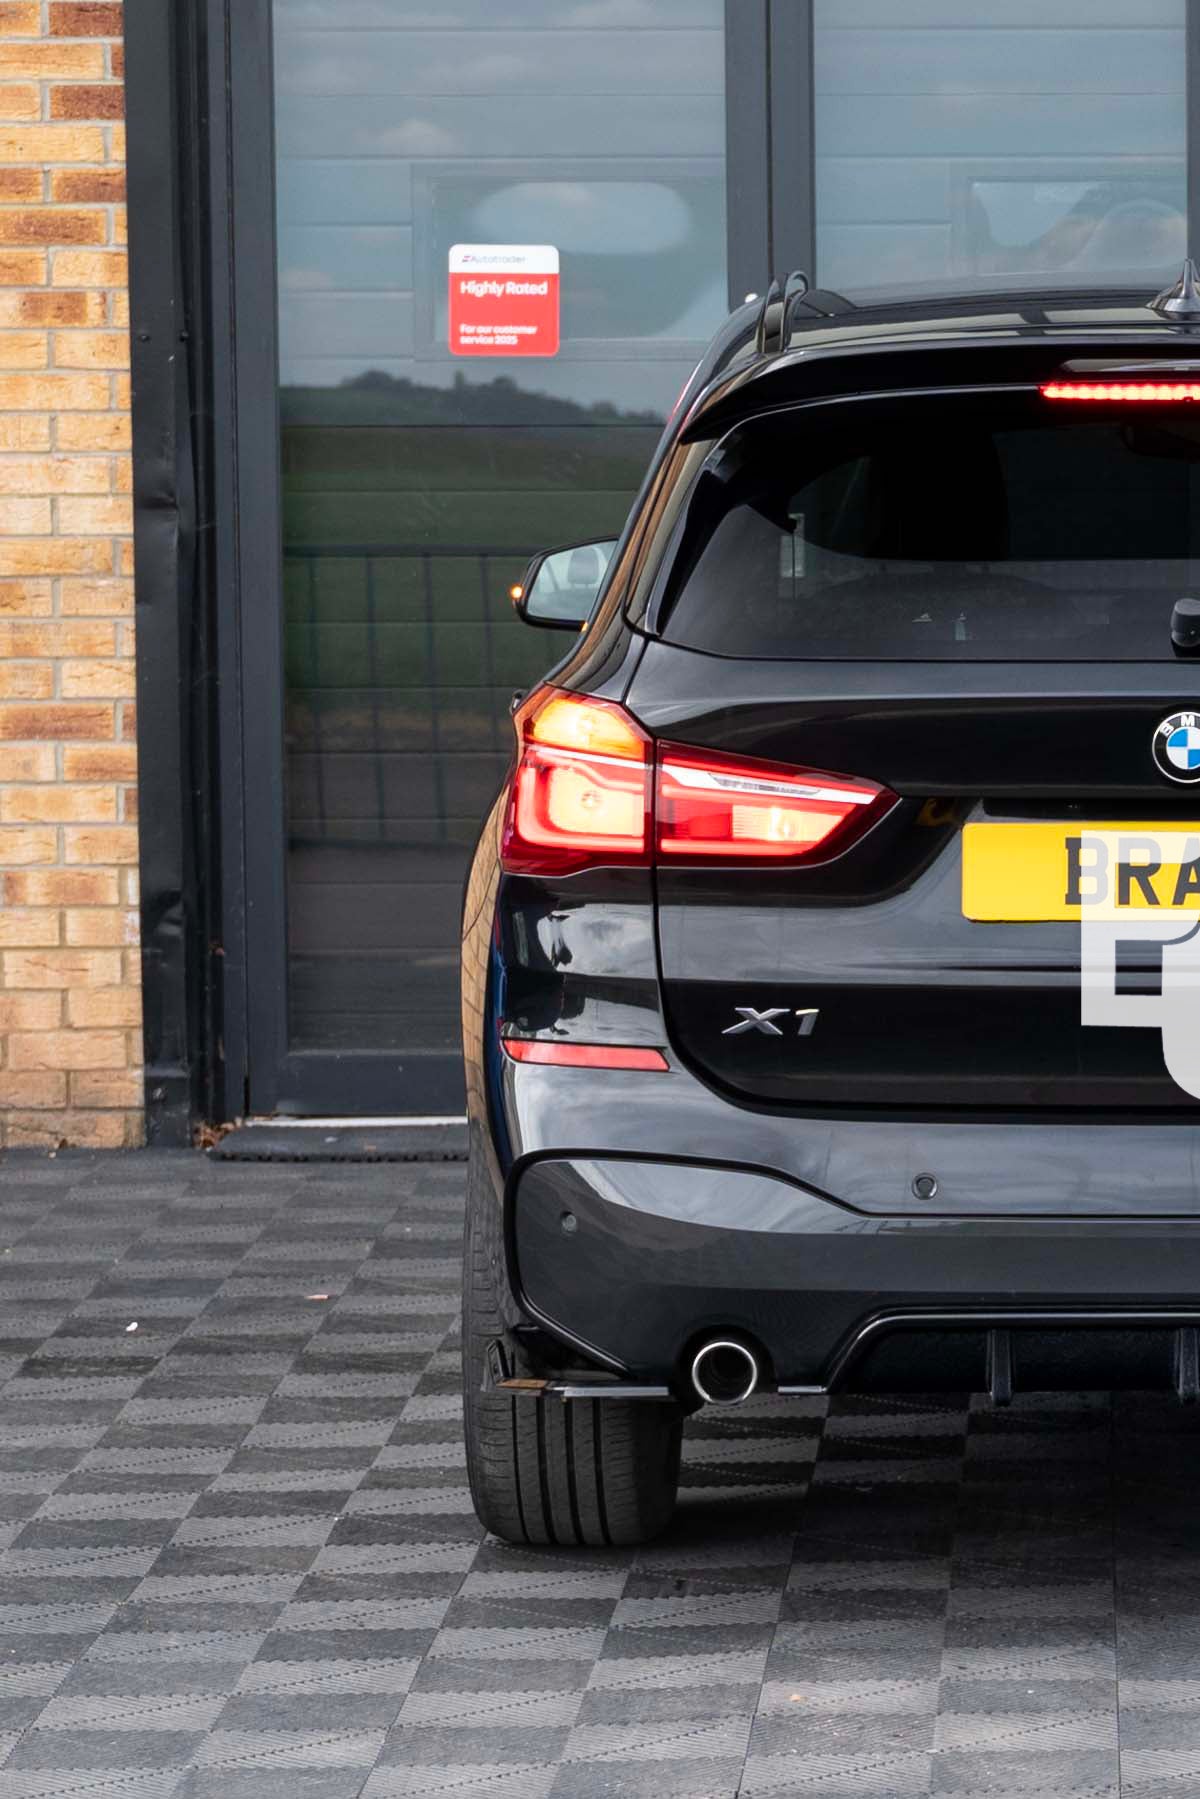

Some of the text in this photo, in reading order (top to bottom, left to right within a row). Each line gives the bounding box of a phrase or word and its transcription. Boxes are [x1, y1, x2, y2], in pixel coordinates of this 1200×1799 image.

[460, 280, 548, 298] Highly Rated
[460, 323, 475, 334] For
[476, 325, 492, 334] our
[721, 1007, 820, 1036] X1
